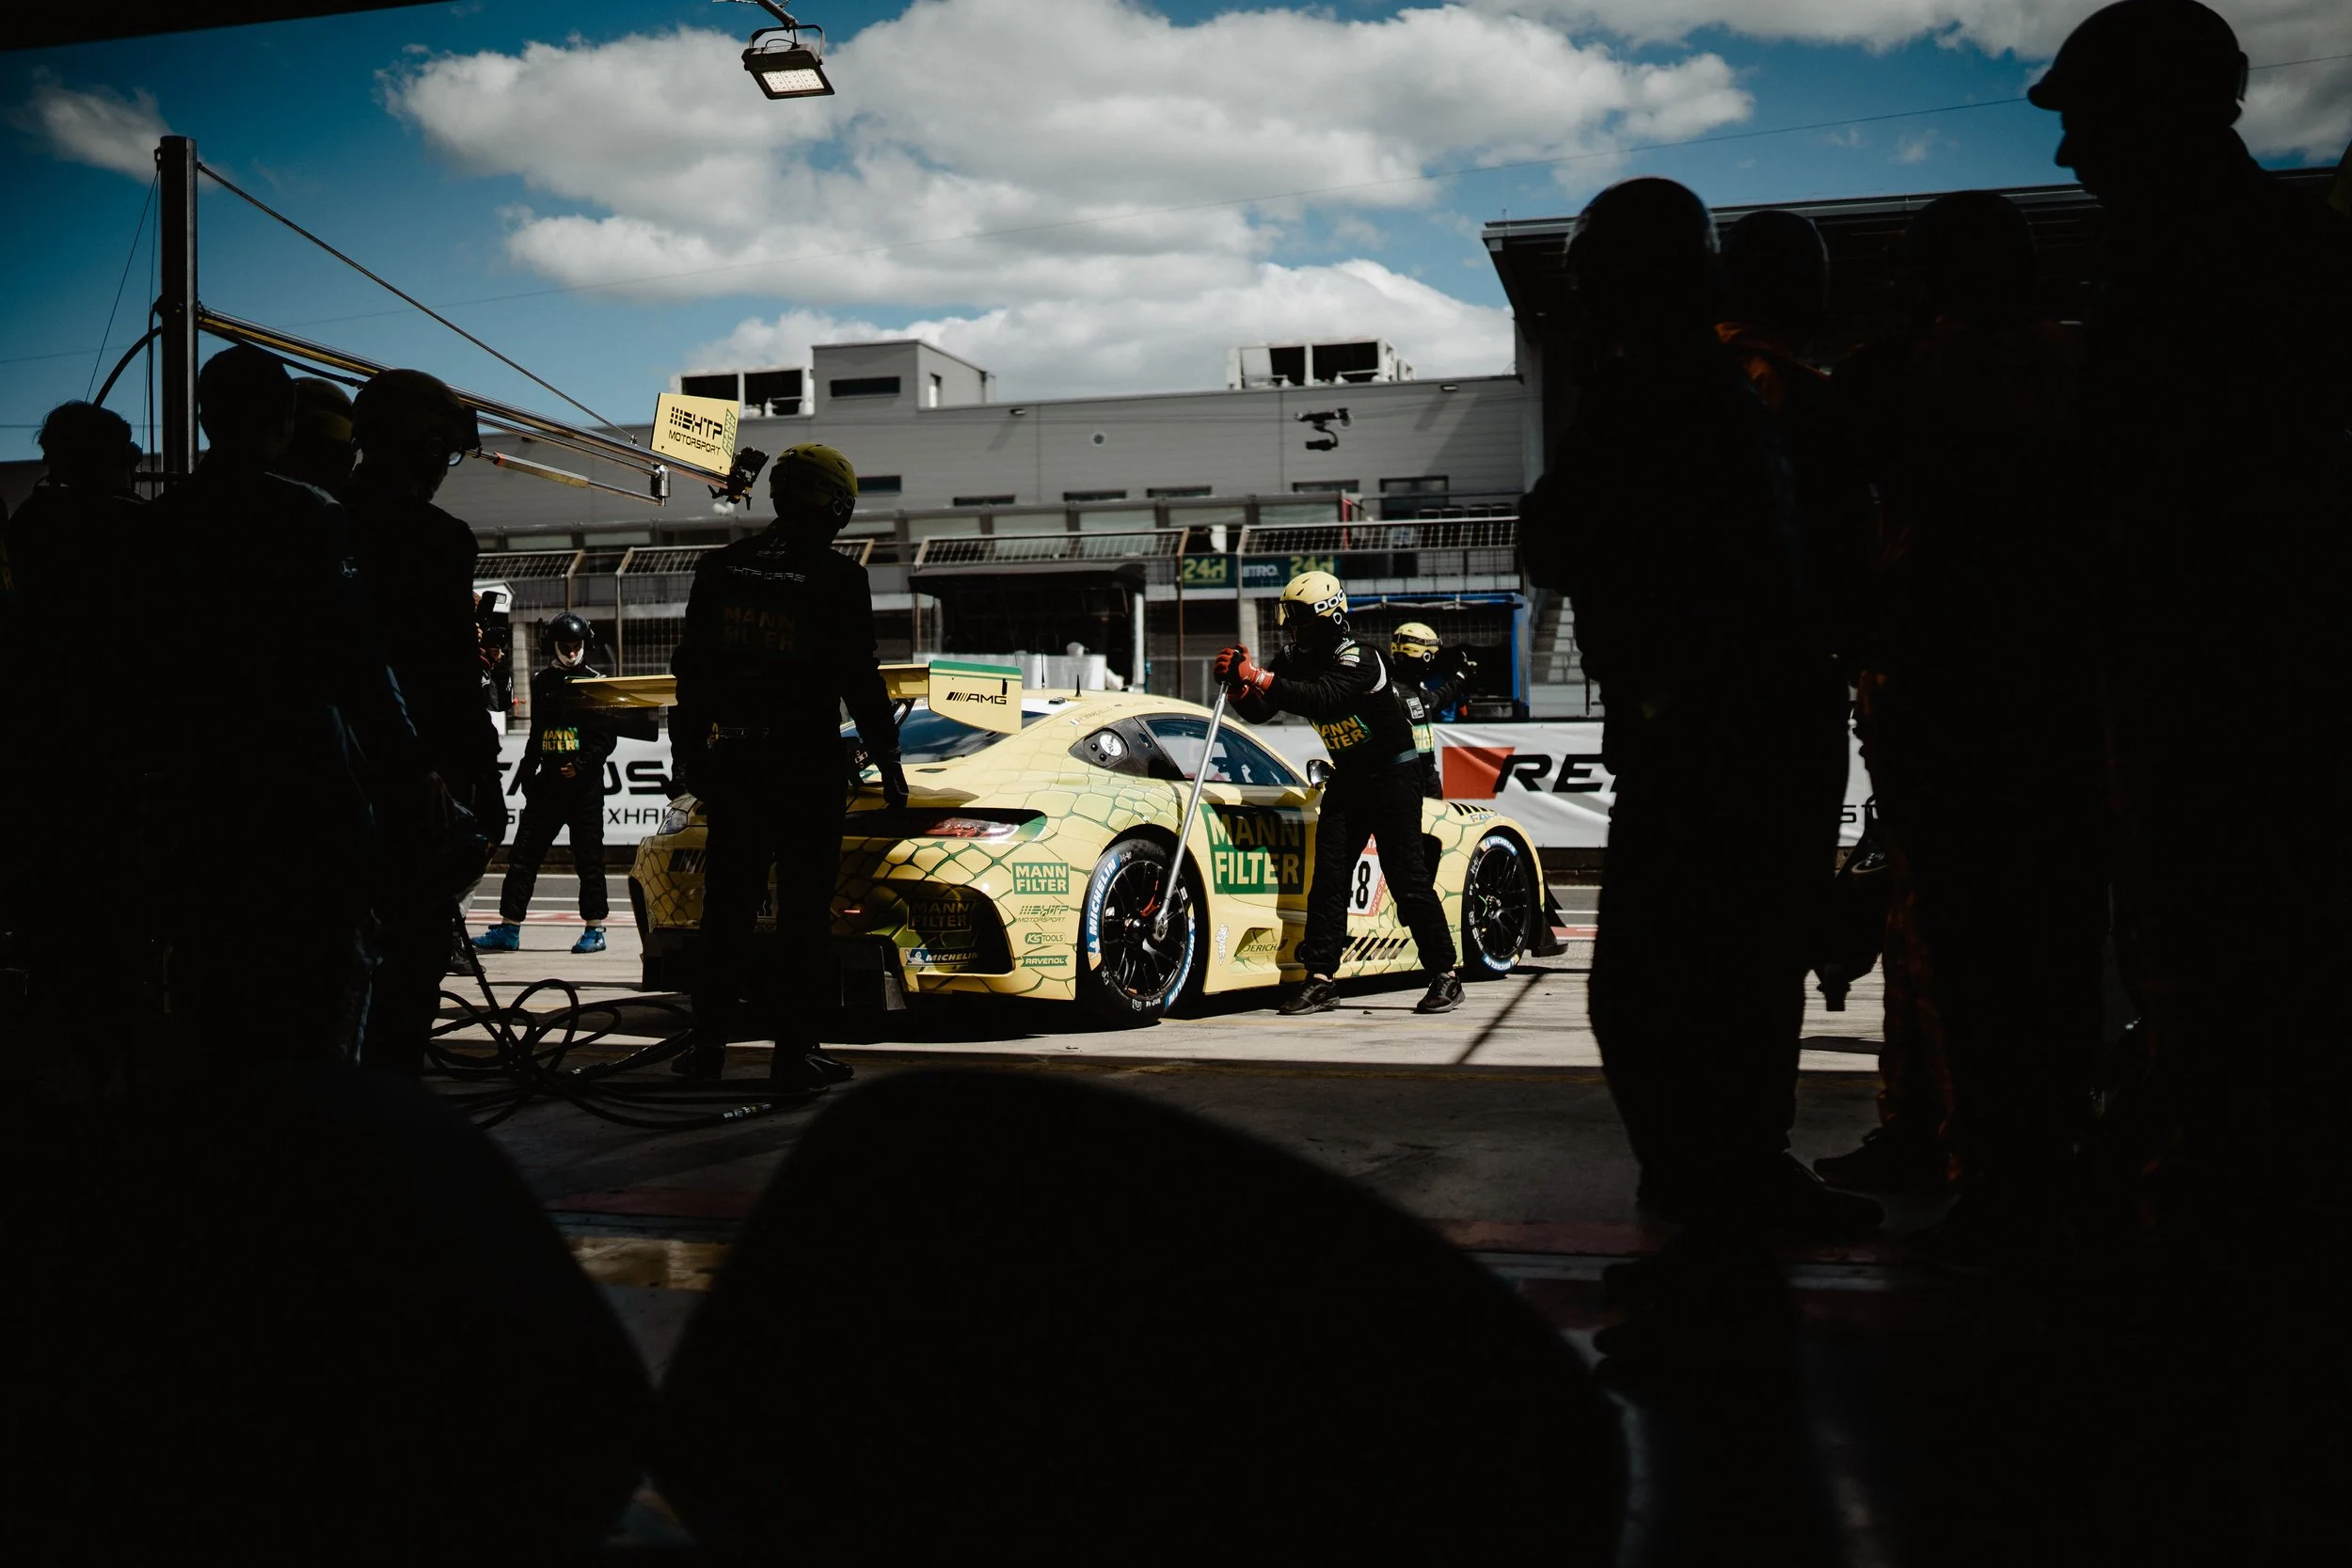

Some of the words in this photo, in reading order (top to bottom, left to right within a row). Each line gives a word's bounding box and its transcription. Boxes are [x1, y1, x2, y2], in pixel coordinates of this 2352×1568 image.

[668, 430, 721, 455] MOTORSPORT
[723, 605, 795, 632] MANN
[965, 693, 1007, 705] AMG
[1325, 729, 1366, 750] LTER
[1207, 813, 1300, 847] MANN
[1015, 865, 1067, 879] MANN
[1214, 851, 1299, 884] FILTER
[1016, 879, 1067, 892] FILTER
[1089, 858, 1117, 936] MICHELIN
[913, 902, 970, 914] MANN
[912, 915, 969, 927] FILTER
[925, 952, 979, 962] MICHELIN
[1025, 957, 1065, 965] RAVENOL
